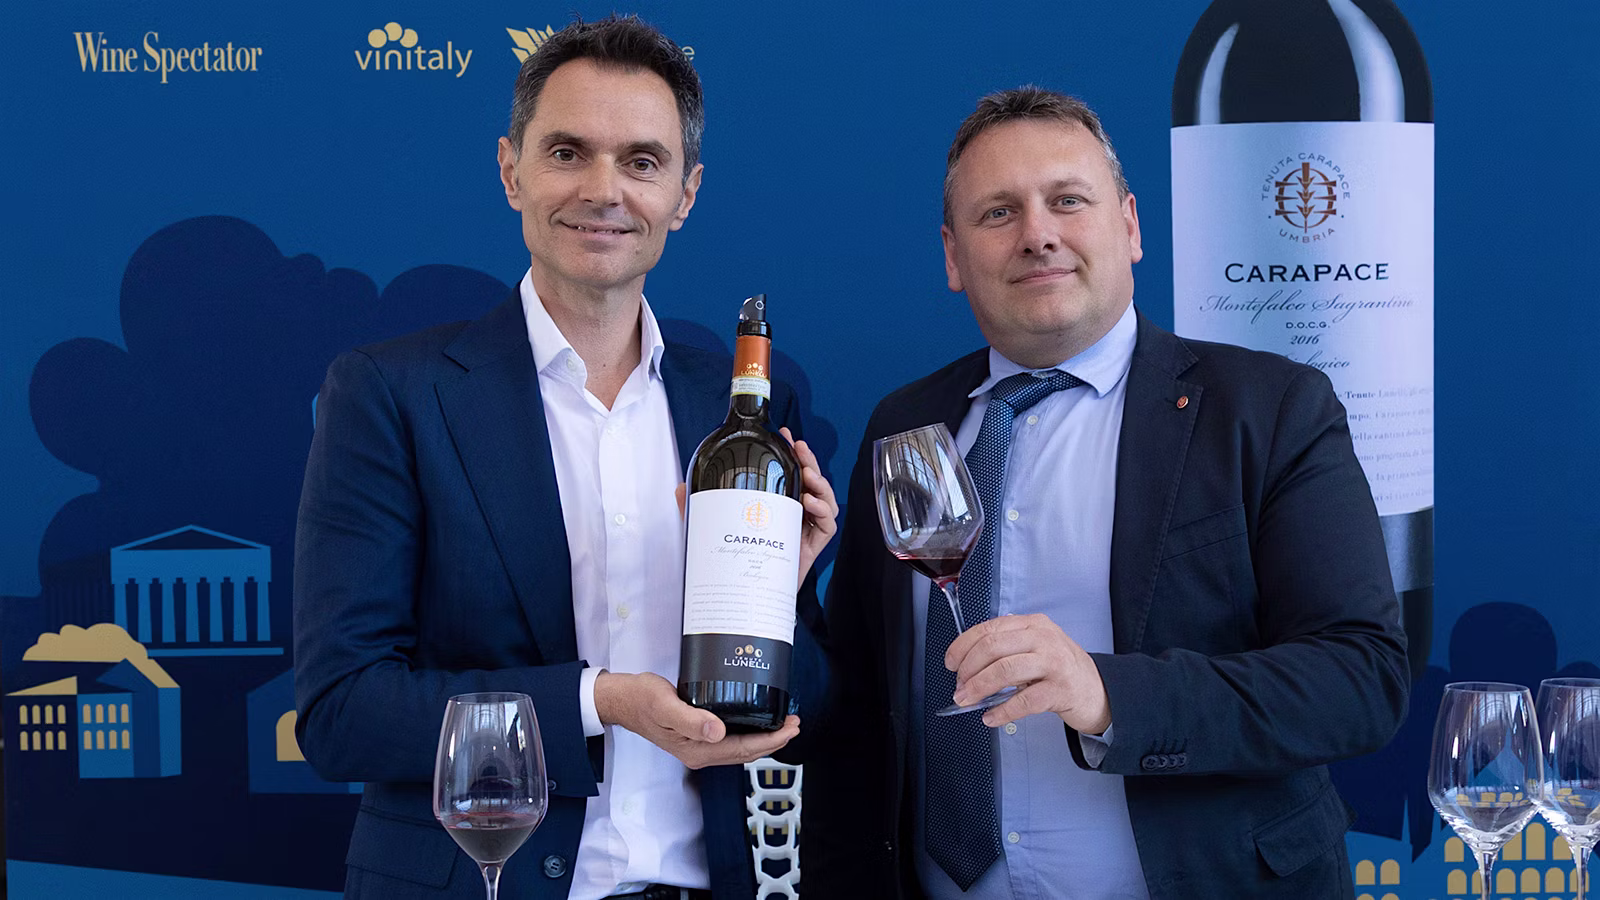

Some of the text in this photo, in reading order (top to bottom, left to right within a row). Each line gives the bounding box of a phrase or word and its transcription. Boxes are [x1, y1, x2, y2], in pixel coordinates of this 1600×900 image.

[73, 31, 263, 84] Wine Spectator
[355, 41, 473, 78] vinitaly
[1262, 152, 1351, 201] TENUTA CARAPACE
[1279, 228, 1335, 243] UMBRIA
[1199, 289, 1306, 324] Montefalco
[1285, 321, 1331, 329] D.O.C.G.
[1290, 334, 1320, 345] 2016
[1344, 390, 1376, 399] Tenute
[724, 658, 770, 670] LUNELLI
